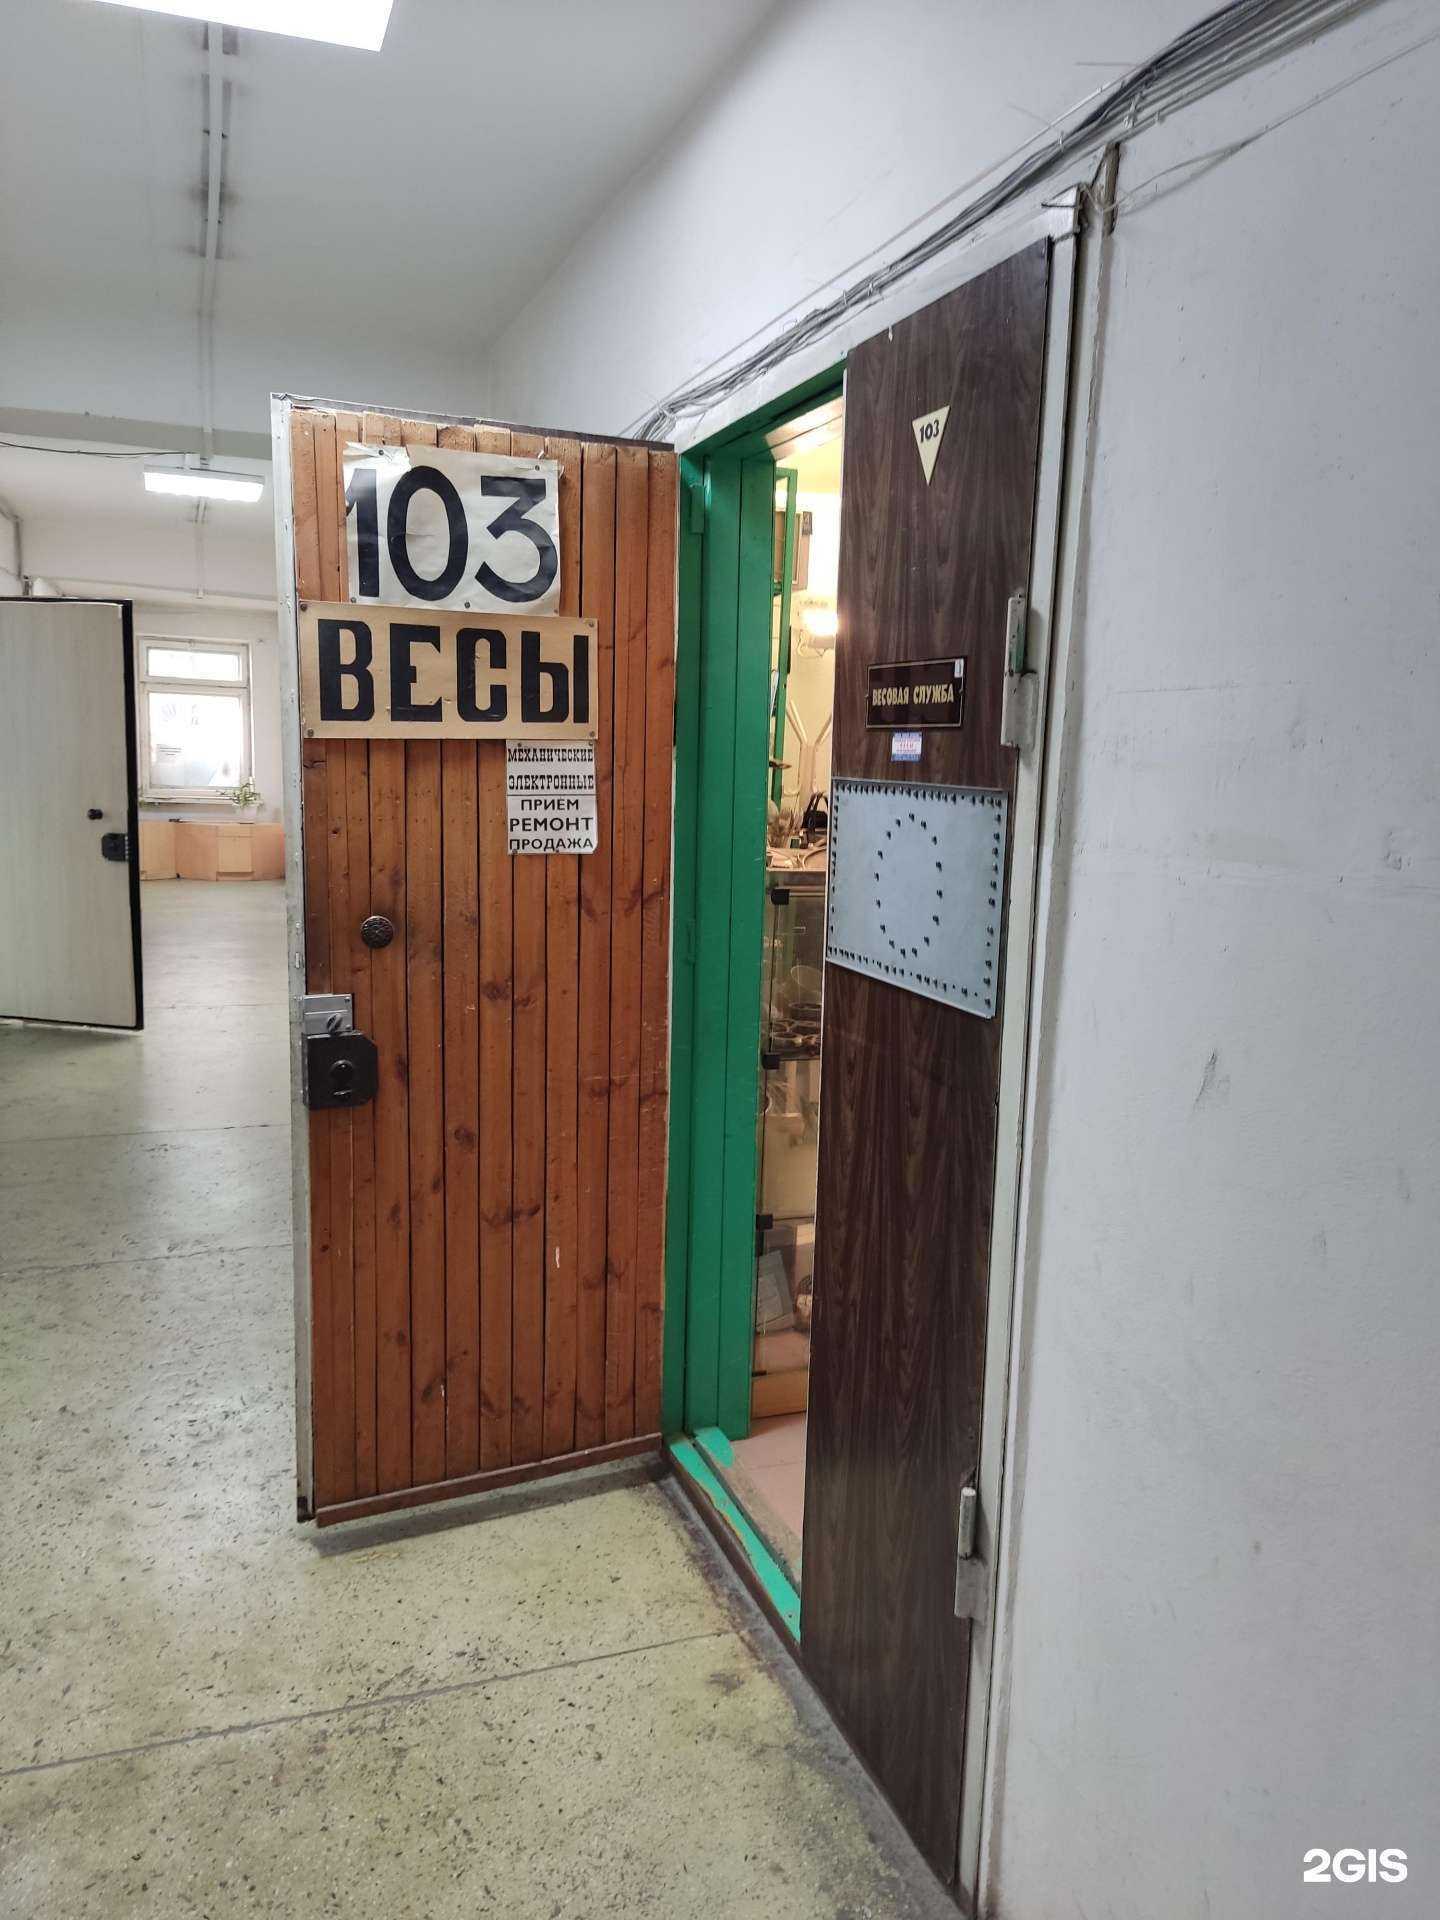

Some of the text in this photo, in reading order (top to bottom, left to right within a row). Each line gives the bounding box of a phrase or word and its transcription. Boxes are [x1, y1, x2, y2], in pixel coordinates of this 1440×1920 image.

[919, 419, 940, 443] 103
[346, 465, 558, 602] 103
[318, 618, 589, 723] ВЕСЫ
[872, 683, 955, 706] ВЕСОВАЯ СЛУЖБА
[508, 748, 593, 762] МЕХАНИЧЕСКИЕ
[508, 775, 594, 790] ЭЛЕКТРОННЫЕ
[521, 799, 579, 811] ПРИЕМ
[510, 817, 594, 832] РЕМОНТ
[509, 838, 593, 852] ПРОДАЖА
